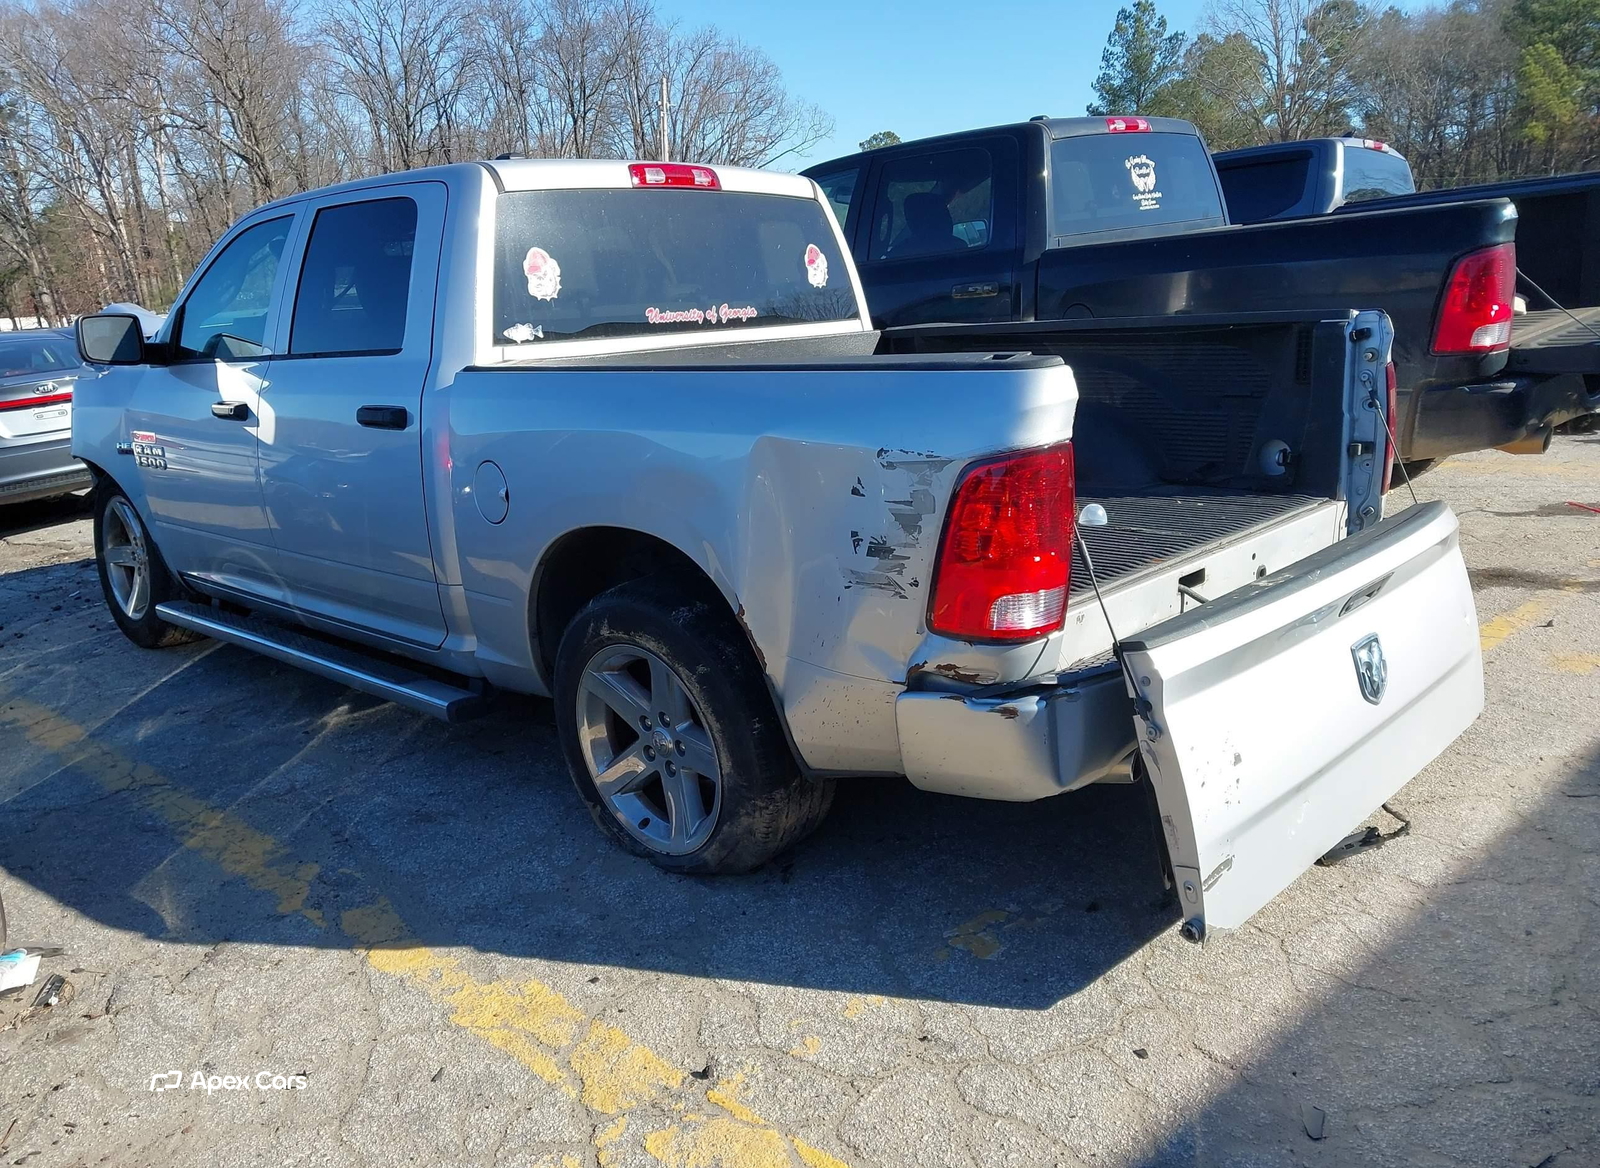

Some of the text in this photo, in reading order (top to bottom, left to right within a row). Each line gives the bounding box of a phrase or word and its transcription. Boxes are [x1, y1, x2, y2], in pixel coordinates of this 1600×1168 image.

[646, 303, 757, 324] University of Georgia
[38, 382, 53, 392] KIA
[135, 444, 164, 457] RAM
[136, 456, 166, 470] 1500
